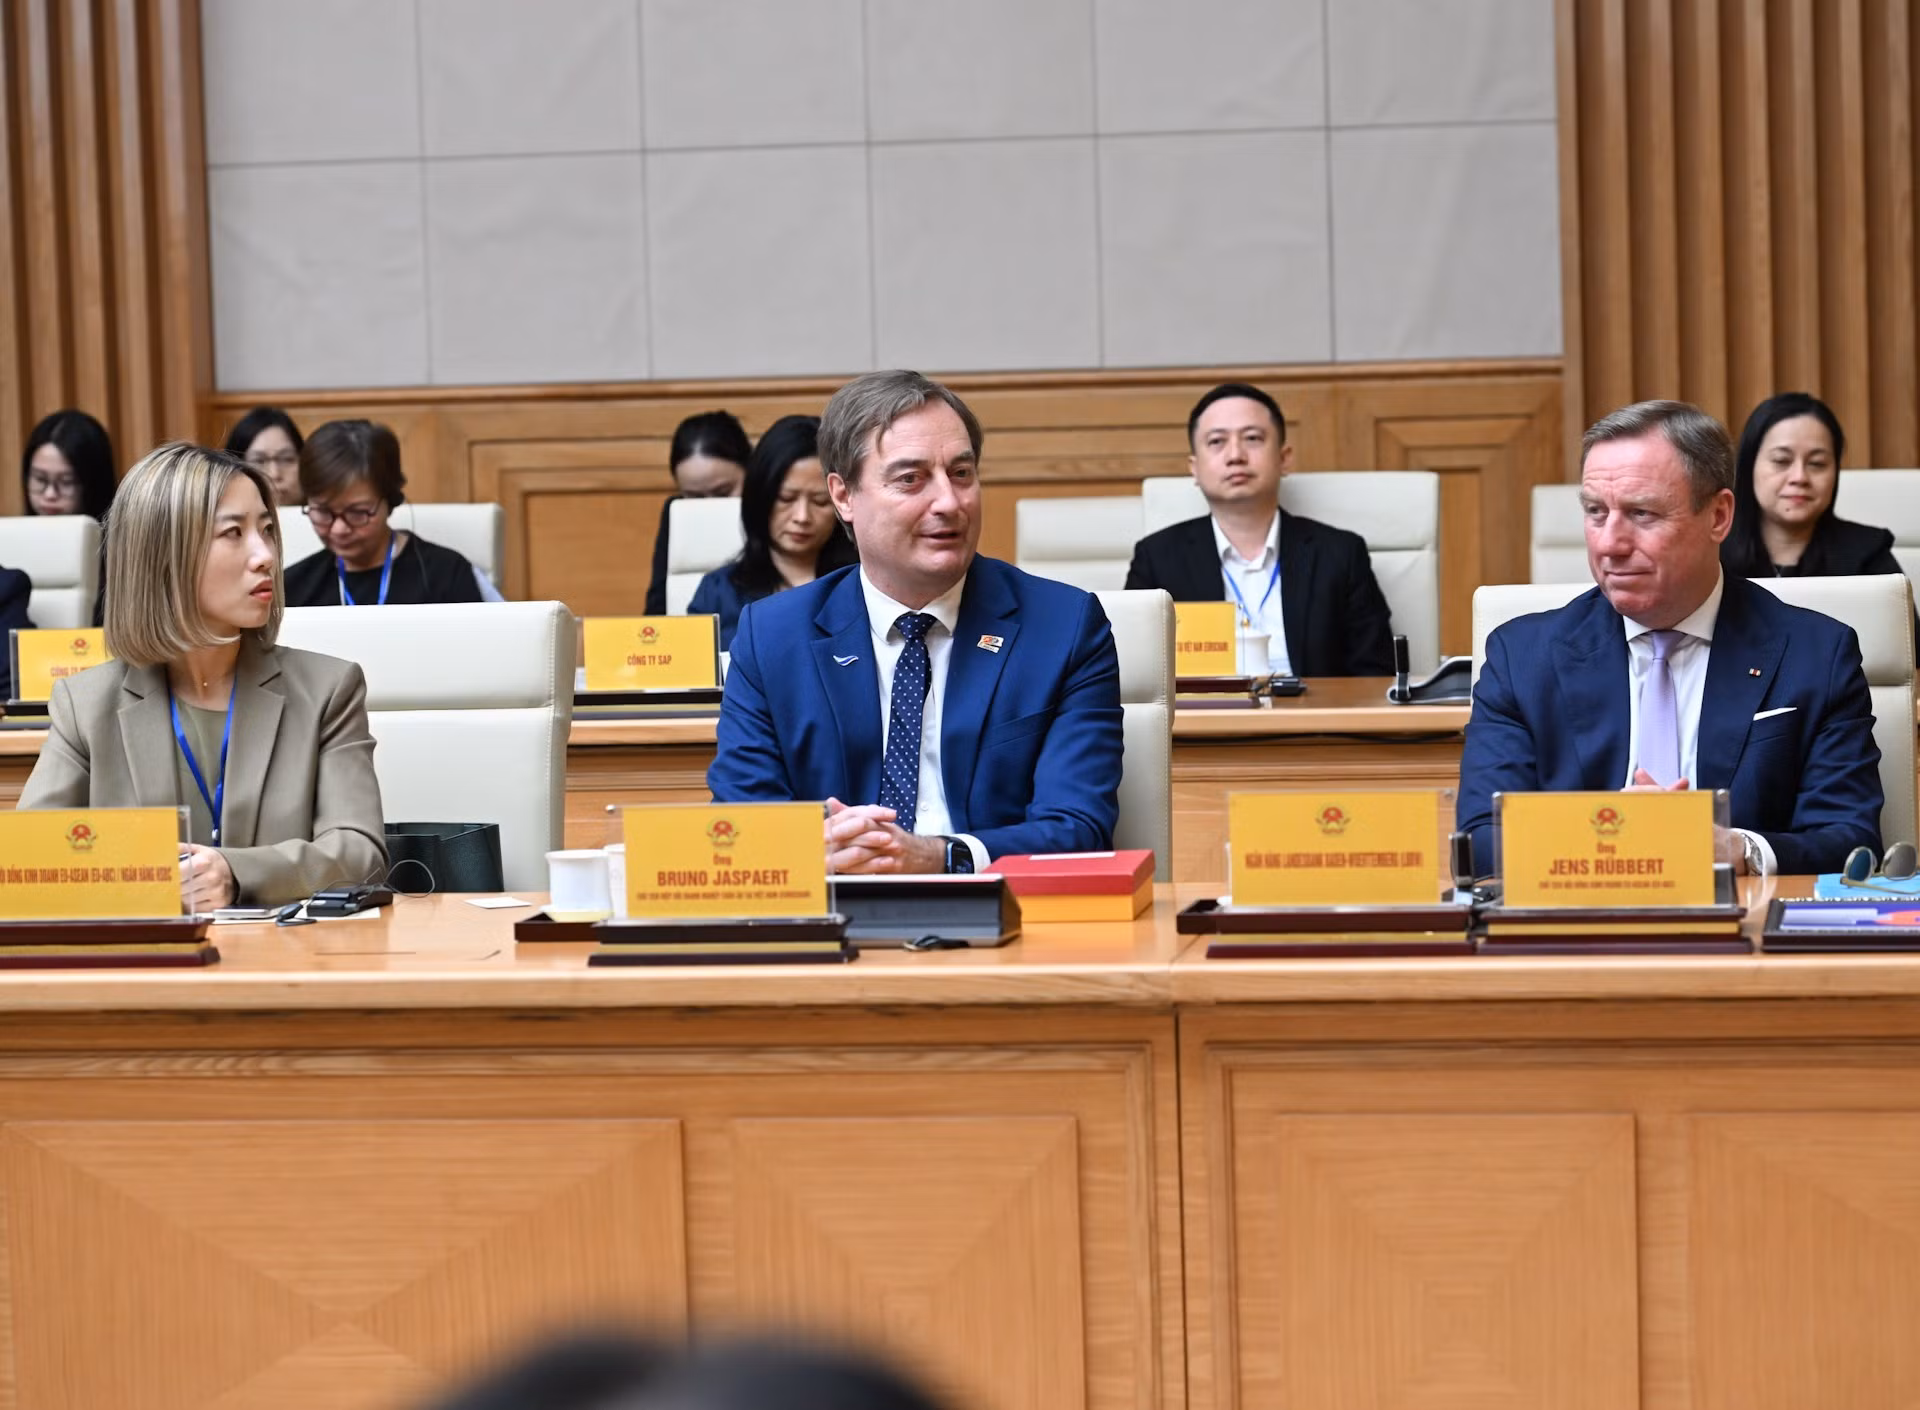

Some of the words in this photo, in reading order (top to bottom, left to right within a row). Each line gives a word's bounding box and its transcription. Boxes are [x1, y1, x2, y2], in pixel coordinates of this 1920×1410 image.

[627, 653, 647, 666] CÔNG
[648, 654, 656, 666] TY
[658, 654, 672, 666] SAP
[1549, 859, 1590, 875] JENS
[1594, 856, 1665, 875] RÜBBERT
[657, 871, 708, 887] BRUNO
[712, 869, 789, 886] JASPAERT
